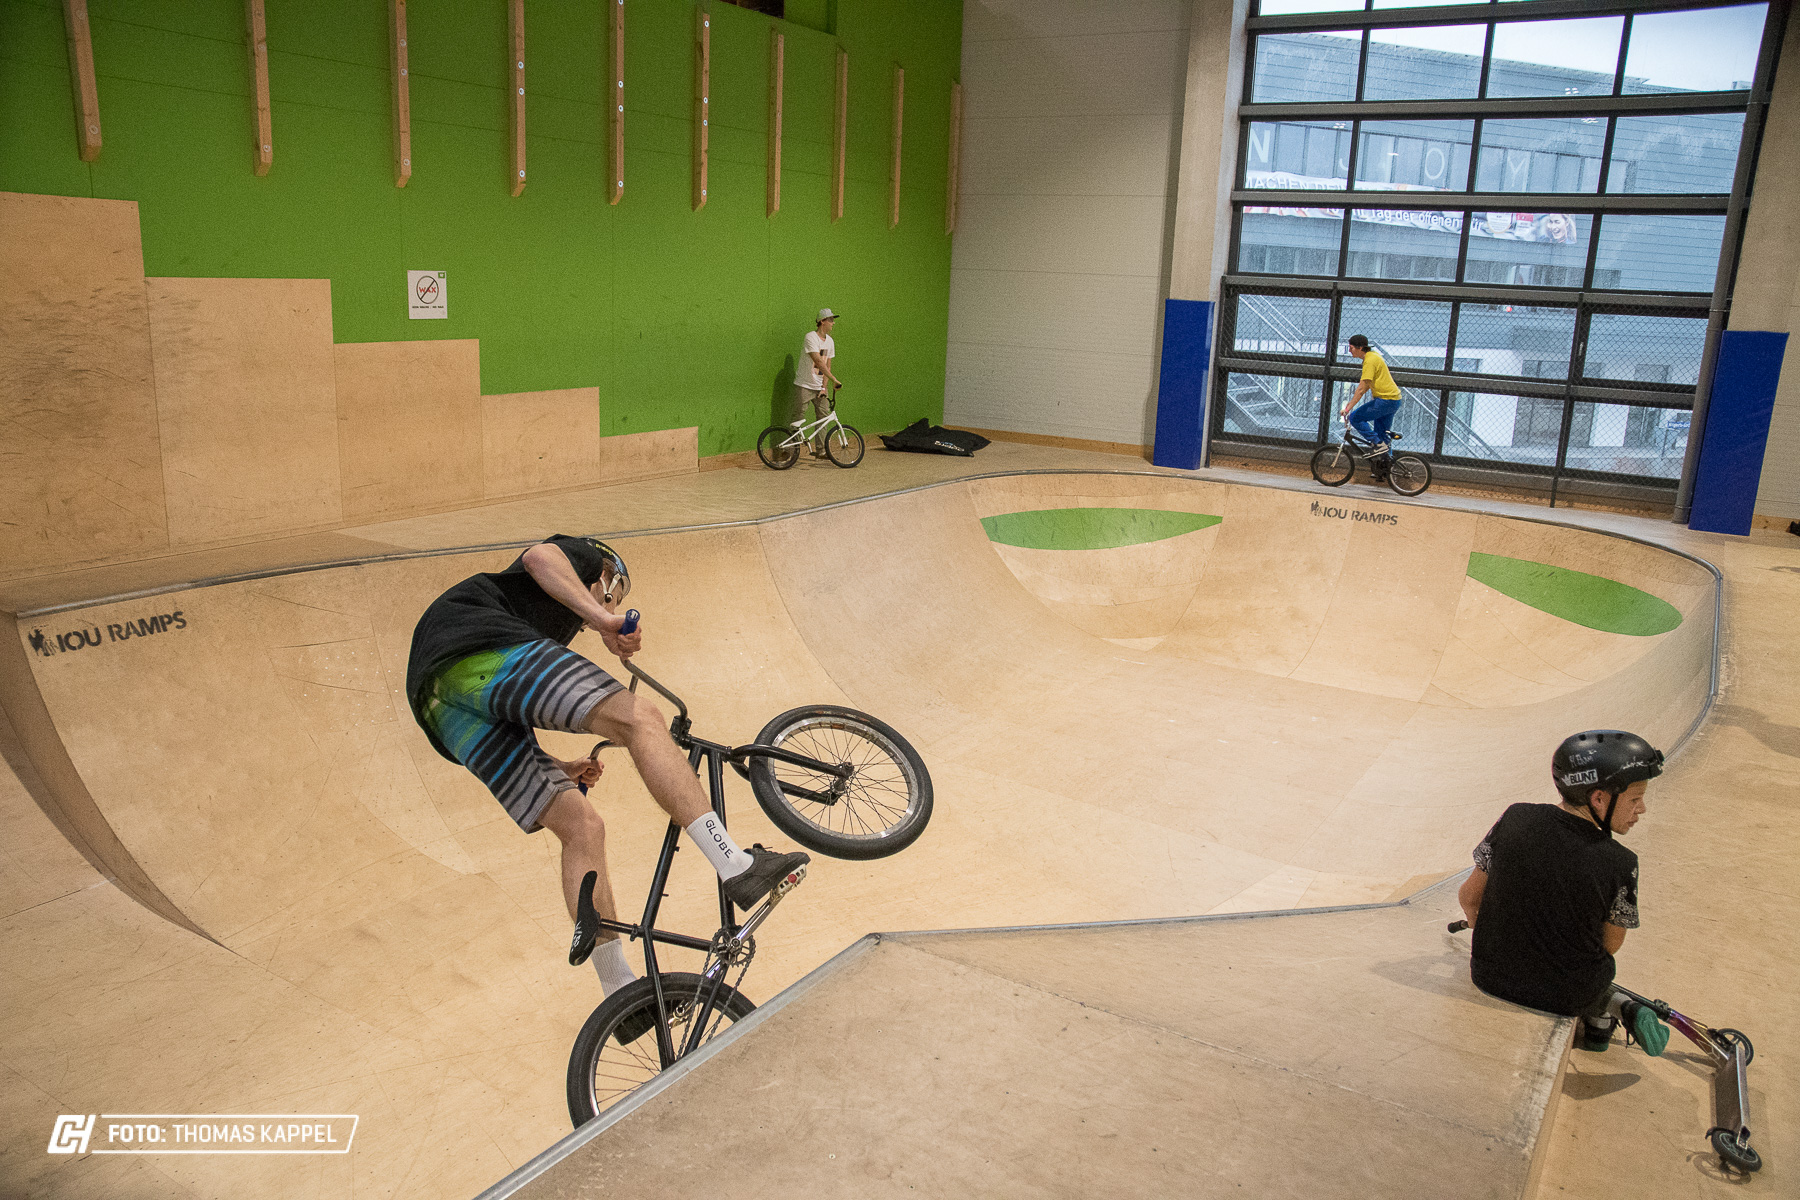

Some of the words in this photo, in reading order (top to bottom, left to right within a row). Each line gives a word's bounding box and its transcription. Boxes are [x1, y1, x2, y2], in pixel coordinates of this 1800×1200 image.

[1396, 211, 1414, 221] der
[1418, 212, 1460, 229] offenen
[1323, 507, 1348, 519] IOU
[1351, 510, 1398, 526] RAMPS
[56, 627, 102, 653] IOU
[107, 611, 187, 642] RAMPS
[1569, 770, 1597, 785] BLUNT
[705, 819, 734, 859] GLOBE
